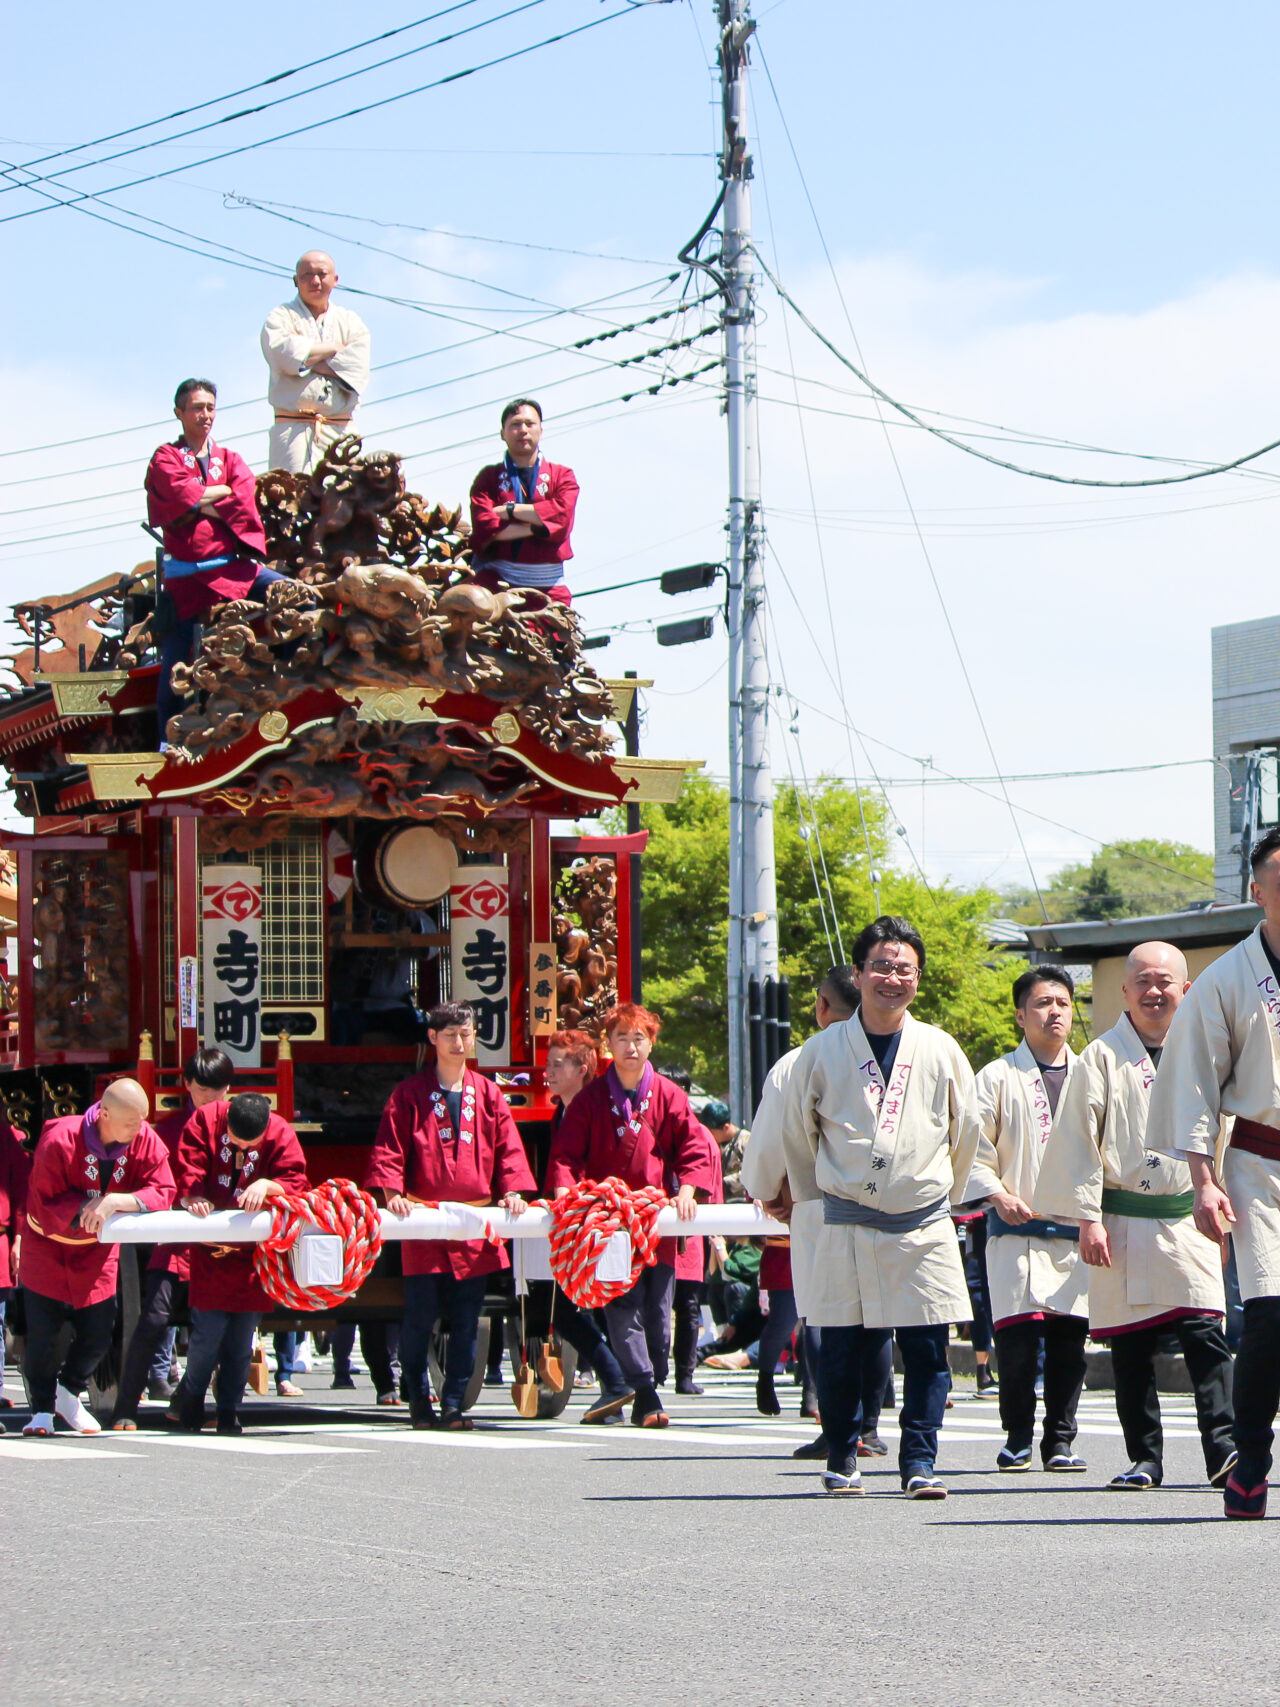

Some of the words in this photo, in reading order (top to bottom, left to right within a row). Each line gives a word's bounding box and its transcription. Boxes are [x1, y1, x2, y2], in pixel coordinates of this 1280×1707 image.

[213, 929, 260, 1053] 寺町
[461, 928, 508, 1051] 寺町
[881, 1063, 911, 1134] てらまち
[1028, 1078, 1051, 1144] てらまち
[864, 1156, 887, 1196] 渉外
